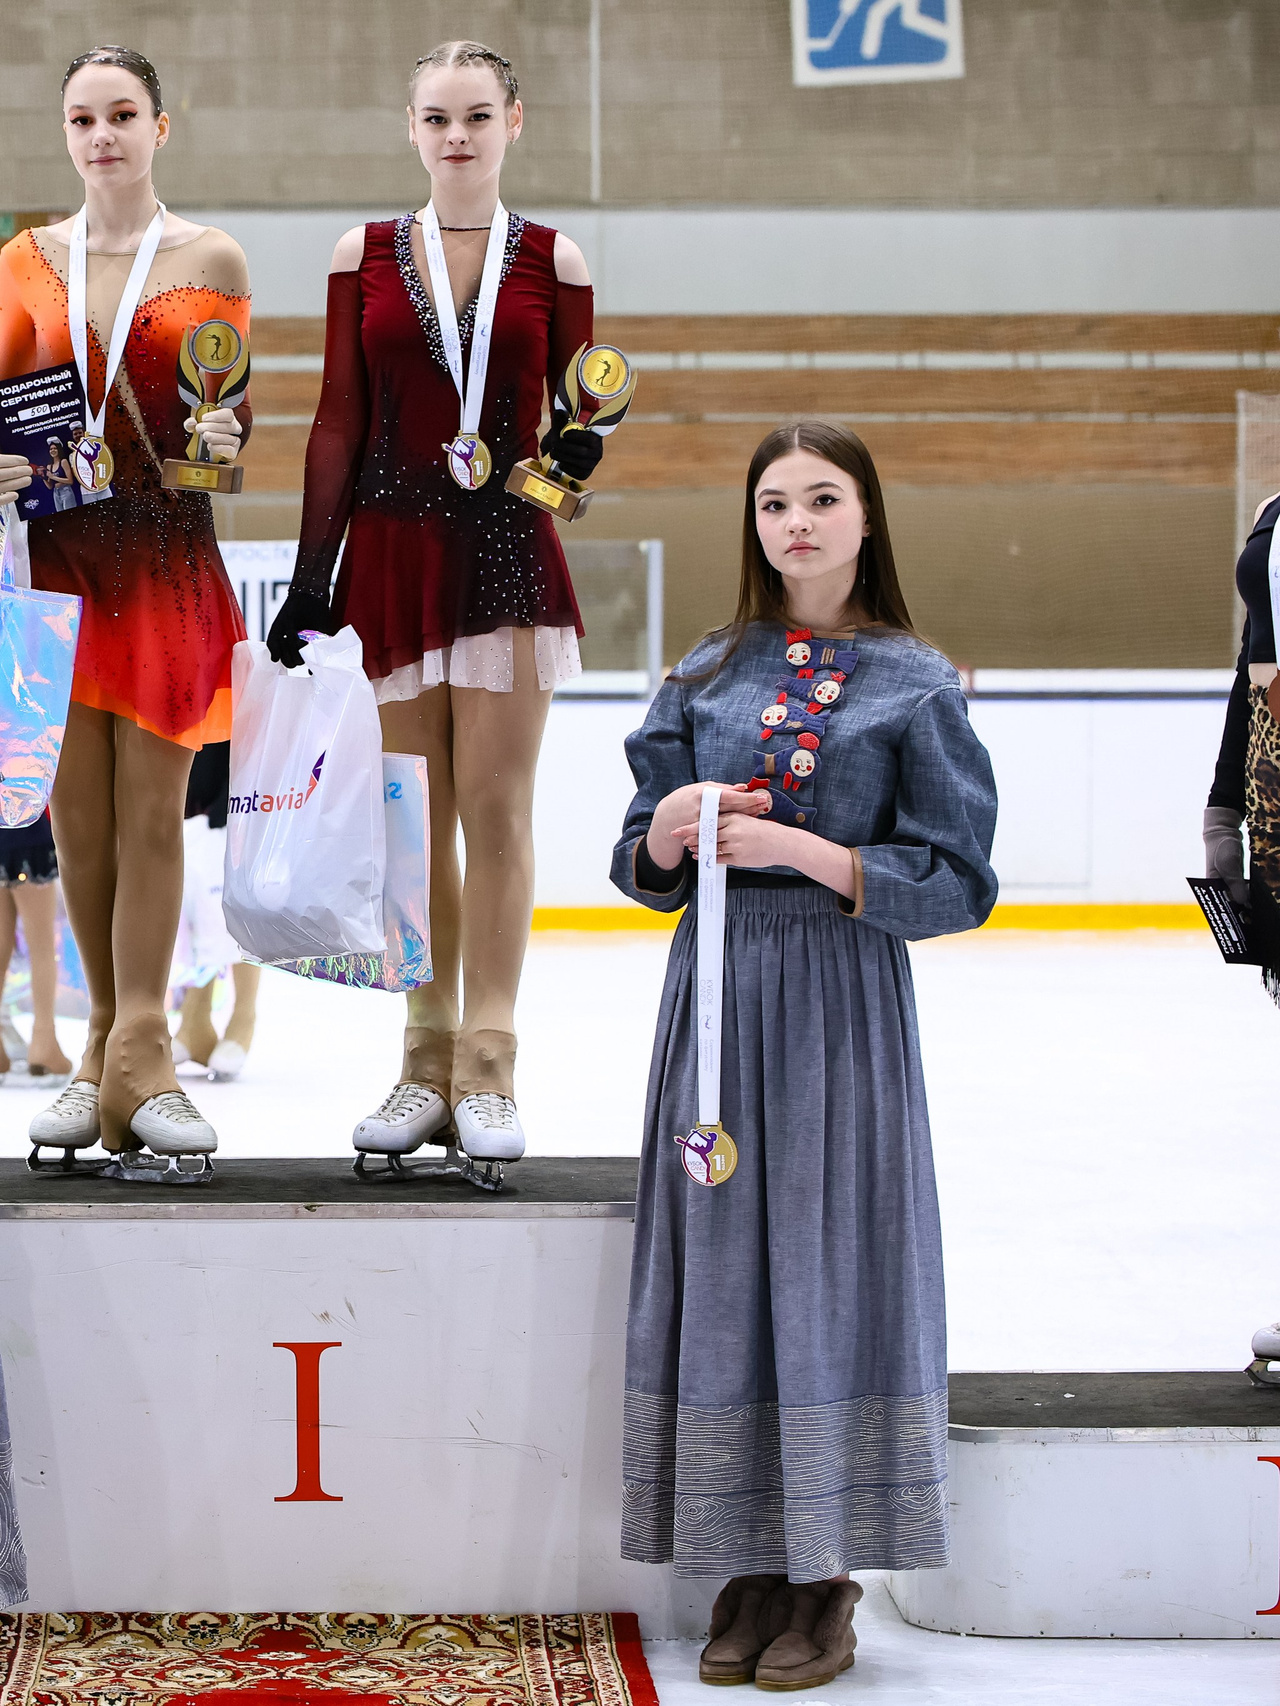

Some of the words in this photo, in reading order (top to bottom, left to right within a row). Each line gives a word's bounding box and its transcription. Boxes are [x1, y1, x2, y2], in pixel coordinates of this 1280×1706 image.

[0, 382, 73, 408] СЕРТИФИКАТ
[5, 415, 18, 424] На
[31, 405, 48, 417] 500
[51, 398, 80, 413] рублей
[712, 1154, 721, 1171] 1
